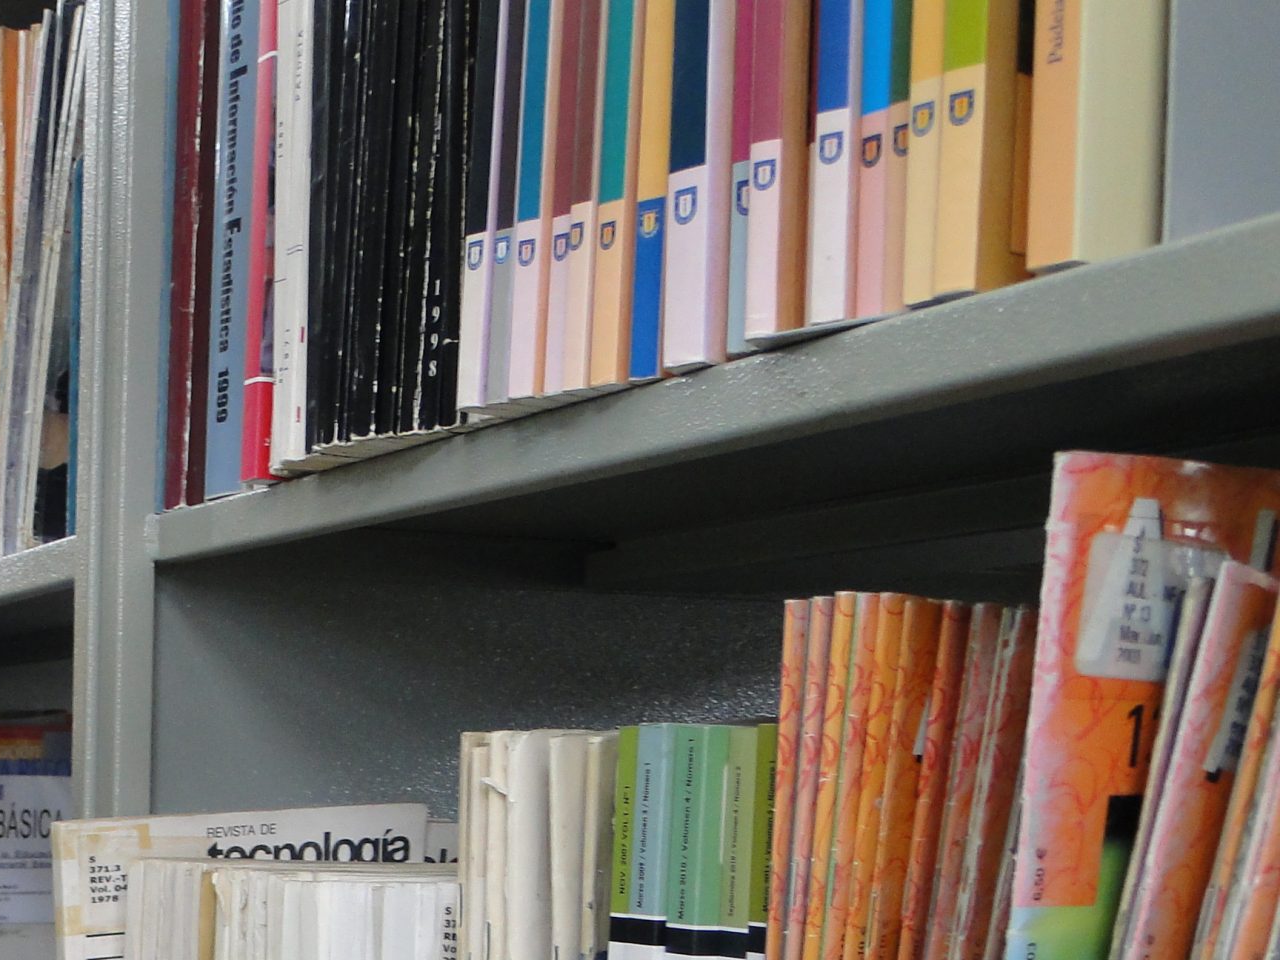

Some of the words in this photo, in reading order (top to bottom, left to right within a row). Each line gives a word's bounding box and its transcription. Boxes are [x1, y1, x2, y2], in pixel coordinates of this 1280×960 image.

[226, 65, 248, 214] Información
[219, 217, 242, 353] Estadística
[428, 279, 441, 377] 1998
[216, 368, 230, 424] 1999
[207, 824, 255, 838] REVISTA
[260, 823, 277, 835] DE
[682, 806, 692, 851] Volumen
[90, 874, 128, 884] REV.-T
